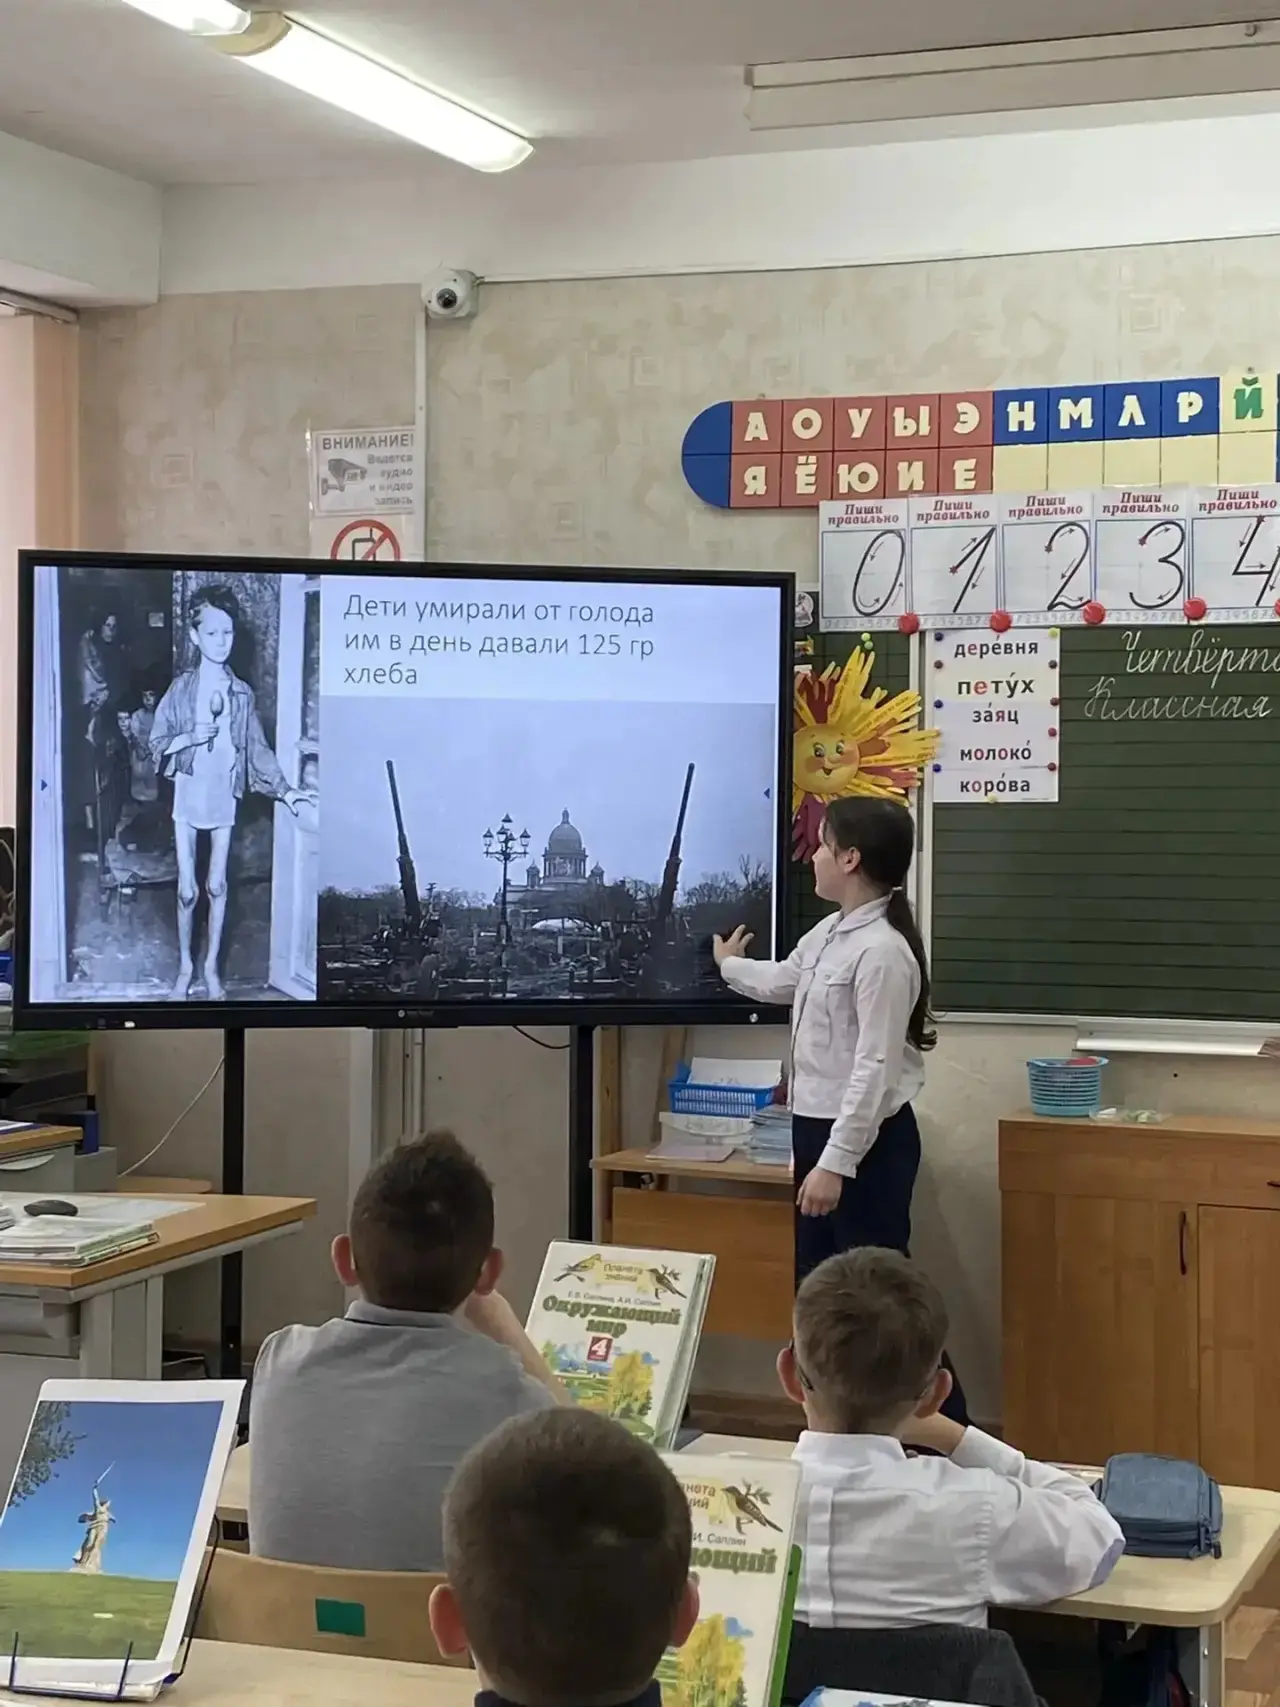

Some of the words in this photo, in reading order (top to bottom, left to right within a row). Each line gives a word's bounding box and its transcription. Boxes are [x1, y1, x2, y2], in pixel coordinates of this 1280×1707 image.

[744, 412, 769, 441] А
[792, 408, 822, 439] О
[847, 408, 873, 438] У
[893, 405, 931, 437] Ы
[953, 401, 980, 434] Э
[1007, 401, 1036, 431] Н
[1058, 397, 1093, 429] М
[1118, 395, 1146, 426] Л
[1176, 391, 1203, 423] Р
[1233, 377, 1264, 419] Й
[321, 433, 414, 450] ВНИМАНИЕ!
[744, 466, 767, 495] Я
[795, 455, 817, 494] Ё
[837, 462, 879, 493] Ю
[897, 460, 924, 491] И
[953, 458, 977, 490] Е
[1025, 495, 1066, 507] Пиши
[1120, 492, 1162, 503] Пиши
[1216, 488, 1260, 501] Пиши
[844, 504, 883, 515] Пиши
[933, 500, 973, 511] Пиши
[1008, 505, 1082, 520] правильно
[1102, 503, 1180, 516] правильно
[1199, 499, 1277, 514] правильно
[828, 514, 899, 527] правильно
[917, 510, 990, 524] правильно
[949, 526, 997, 613] 1
[1044, 521, 1092, 611] 2
[1129, 520, 1185, 609] 3
[1232, 514, 1280, 607] 4
[852, 529, 905, 617] 0
[344, 594, 406, 620] Дети
[415, 600, 526, 623] умирали
[534, 604, 561, 620] от
[569, 604, 654, 627] голода
[345, 633, 380, 650] им
[390, 634, 401, 650] в
[409, 635, 471, 655] день
[479, 636, 569, 657] давали
[579, 634, 621, 655] 125
[630, 639, 654, 660] гр
[344, 662, 417, 684] хлеба
[1084, 676, 1273, 720] Классная
[591, 1338, 607, 1356] 4
